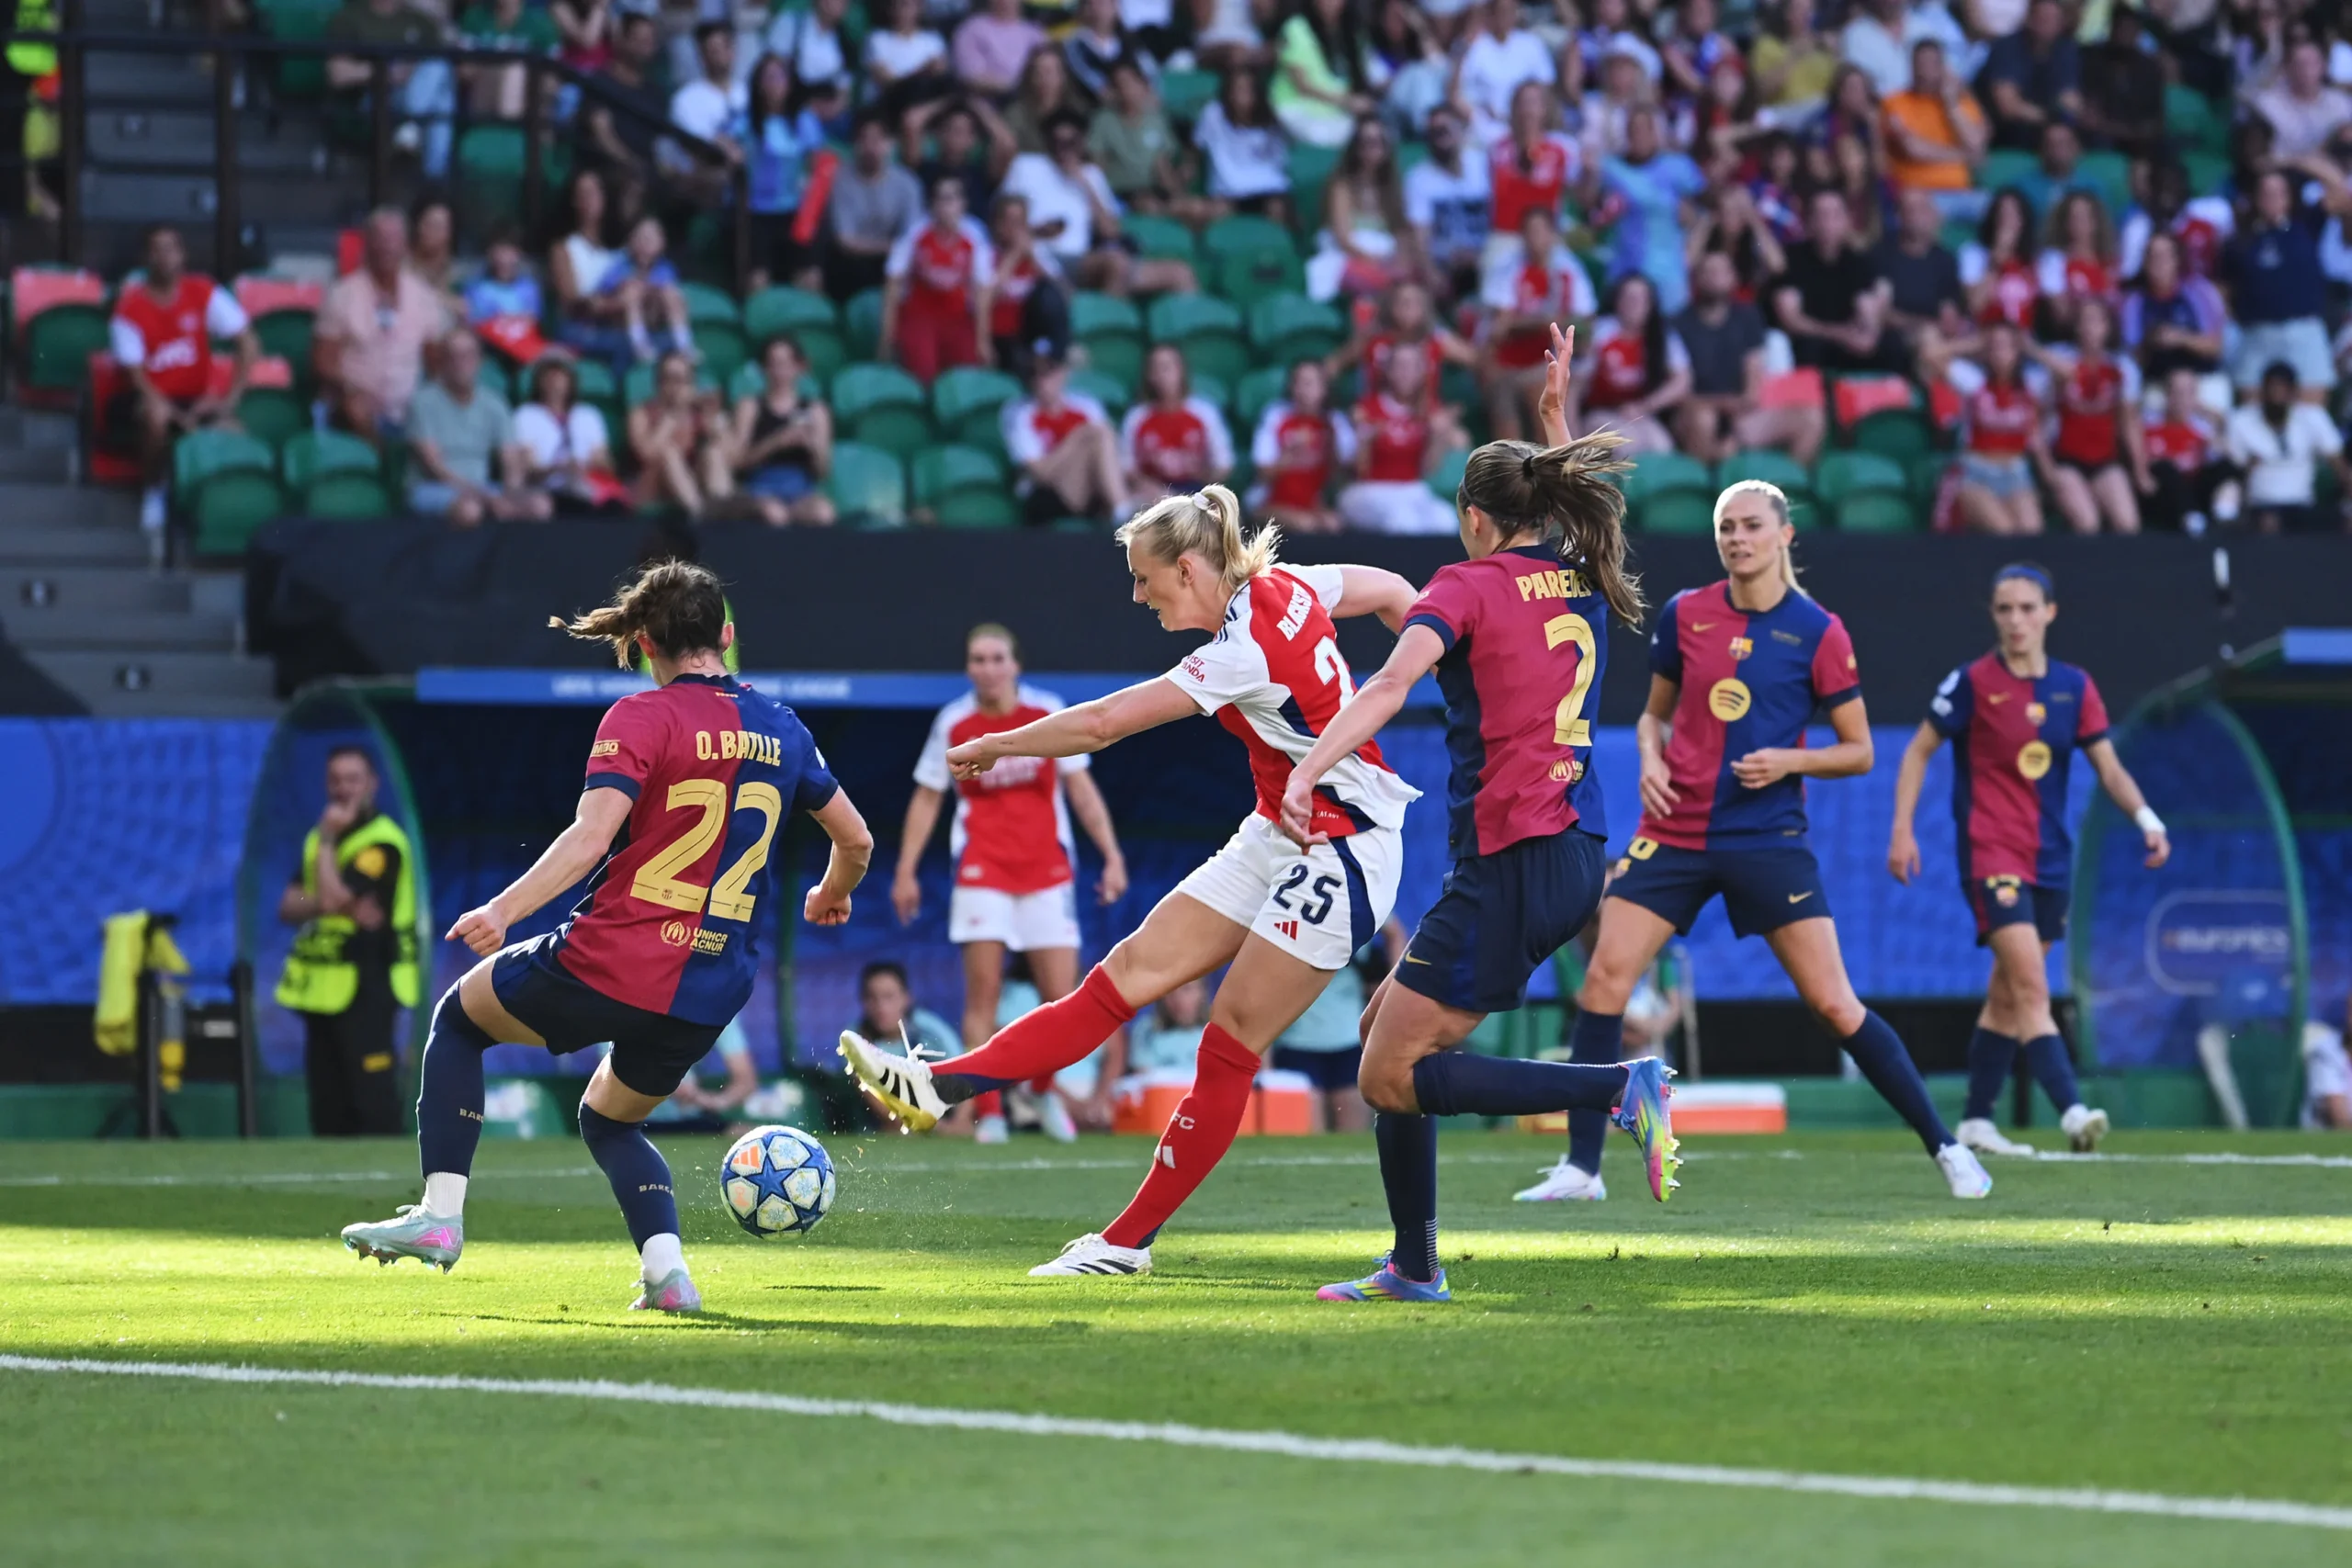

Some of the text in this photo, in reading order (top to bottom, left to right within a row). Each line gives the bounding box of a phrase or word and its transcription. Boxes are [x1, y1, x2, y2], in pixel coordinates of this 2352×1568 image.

[1544, 613, 1597, 747] 2
[695, 731, 781, 767] O.BATLLE
[630, 778, 782, 923] 22
[1273, 863, 1342, 926] 25
[689, 937, 724, 953] ACNUR
[693, 927, 728, 943] UNHCR
